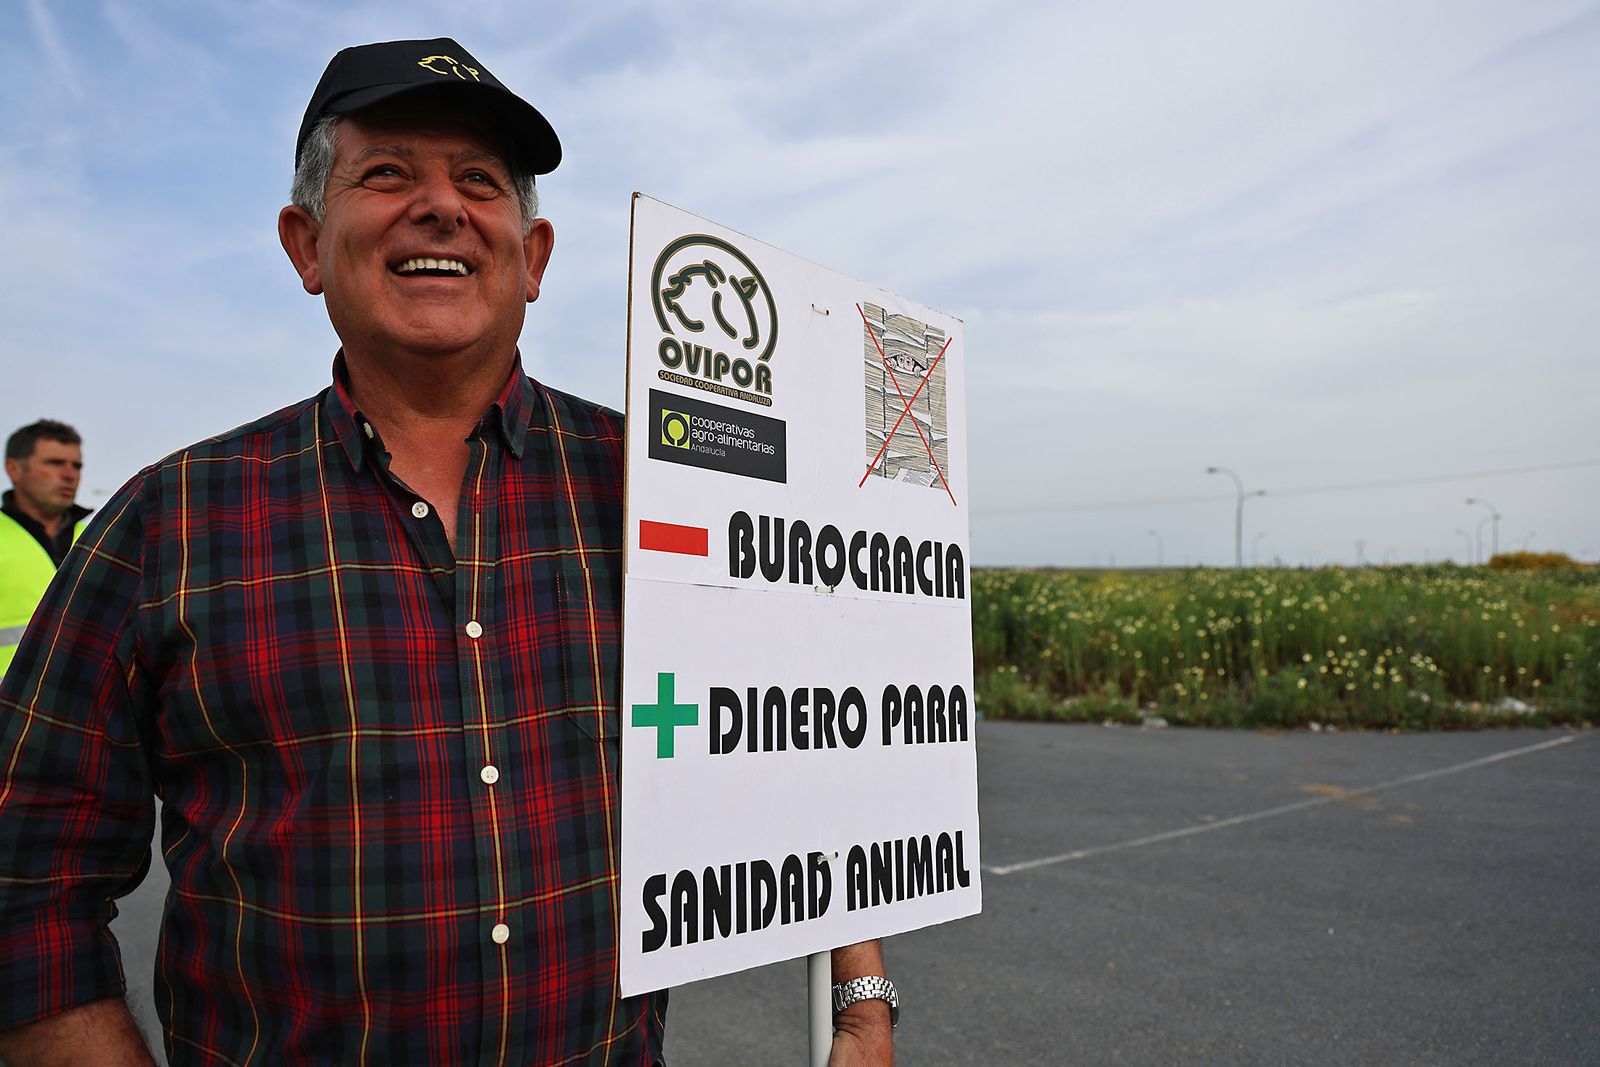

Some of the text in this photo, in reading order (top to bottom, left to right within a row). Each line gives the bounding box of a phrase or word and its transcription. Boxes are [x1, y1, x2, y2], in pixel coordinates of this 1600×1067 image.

[658, 336, 773, 396] OVIPOR
[659, 370, 772, 407] SOCIEDAD COOPERATIVA ANDALUZA
[691, 416, 755, 439] cooperativas
[691, 428, 775, 455] agro-alimentarias
[728, 510, 965, 600] BUROCRACIA
[709, 684, 968, 755] DINERO PARA
[641, 830, 971, 954] SANIDAD ANIMAL
